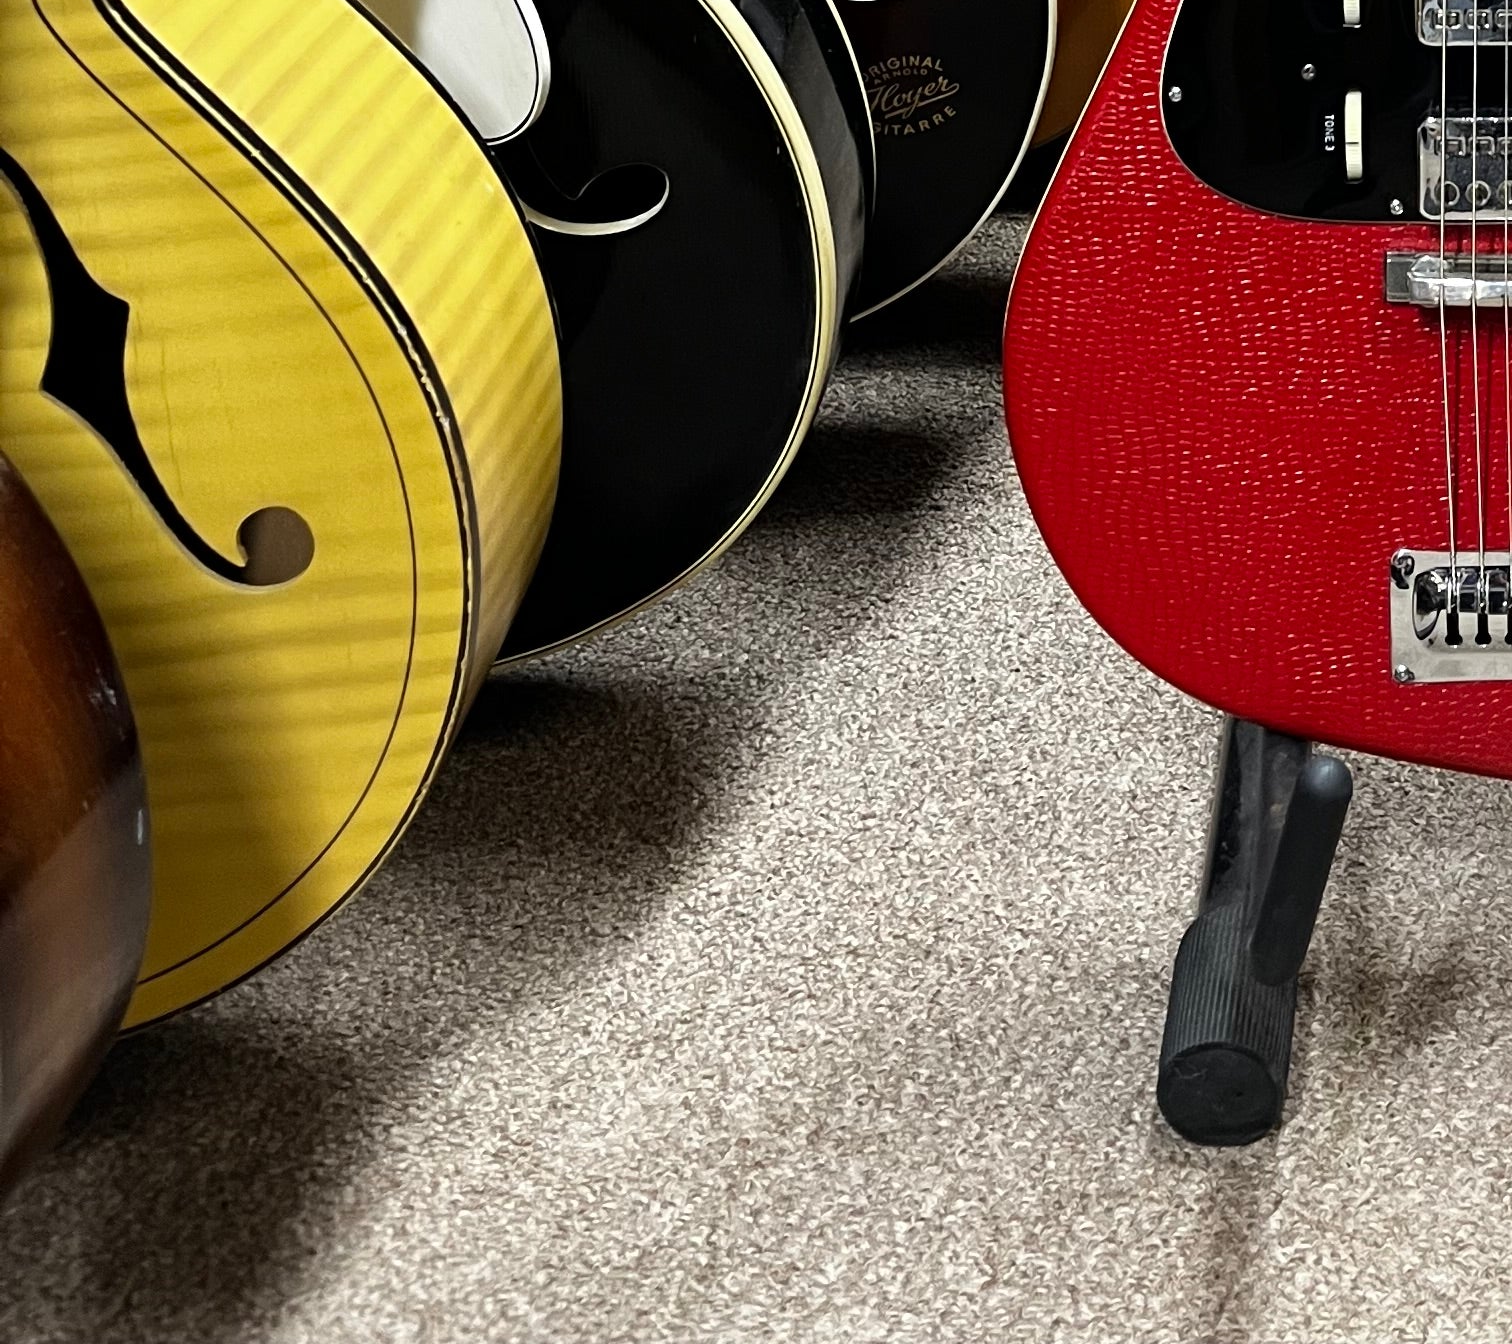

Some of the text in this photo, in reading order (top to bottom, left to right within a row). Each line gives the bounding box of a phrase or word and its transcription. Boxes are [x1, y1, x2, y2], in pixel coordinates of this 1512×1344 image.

[867, 75, 960, 120] Hoyer
[873, 106, 957, 136] GITARRE
[1324, 114, 1336, 152] TONE 3
